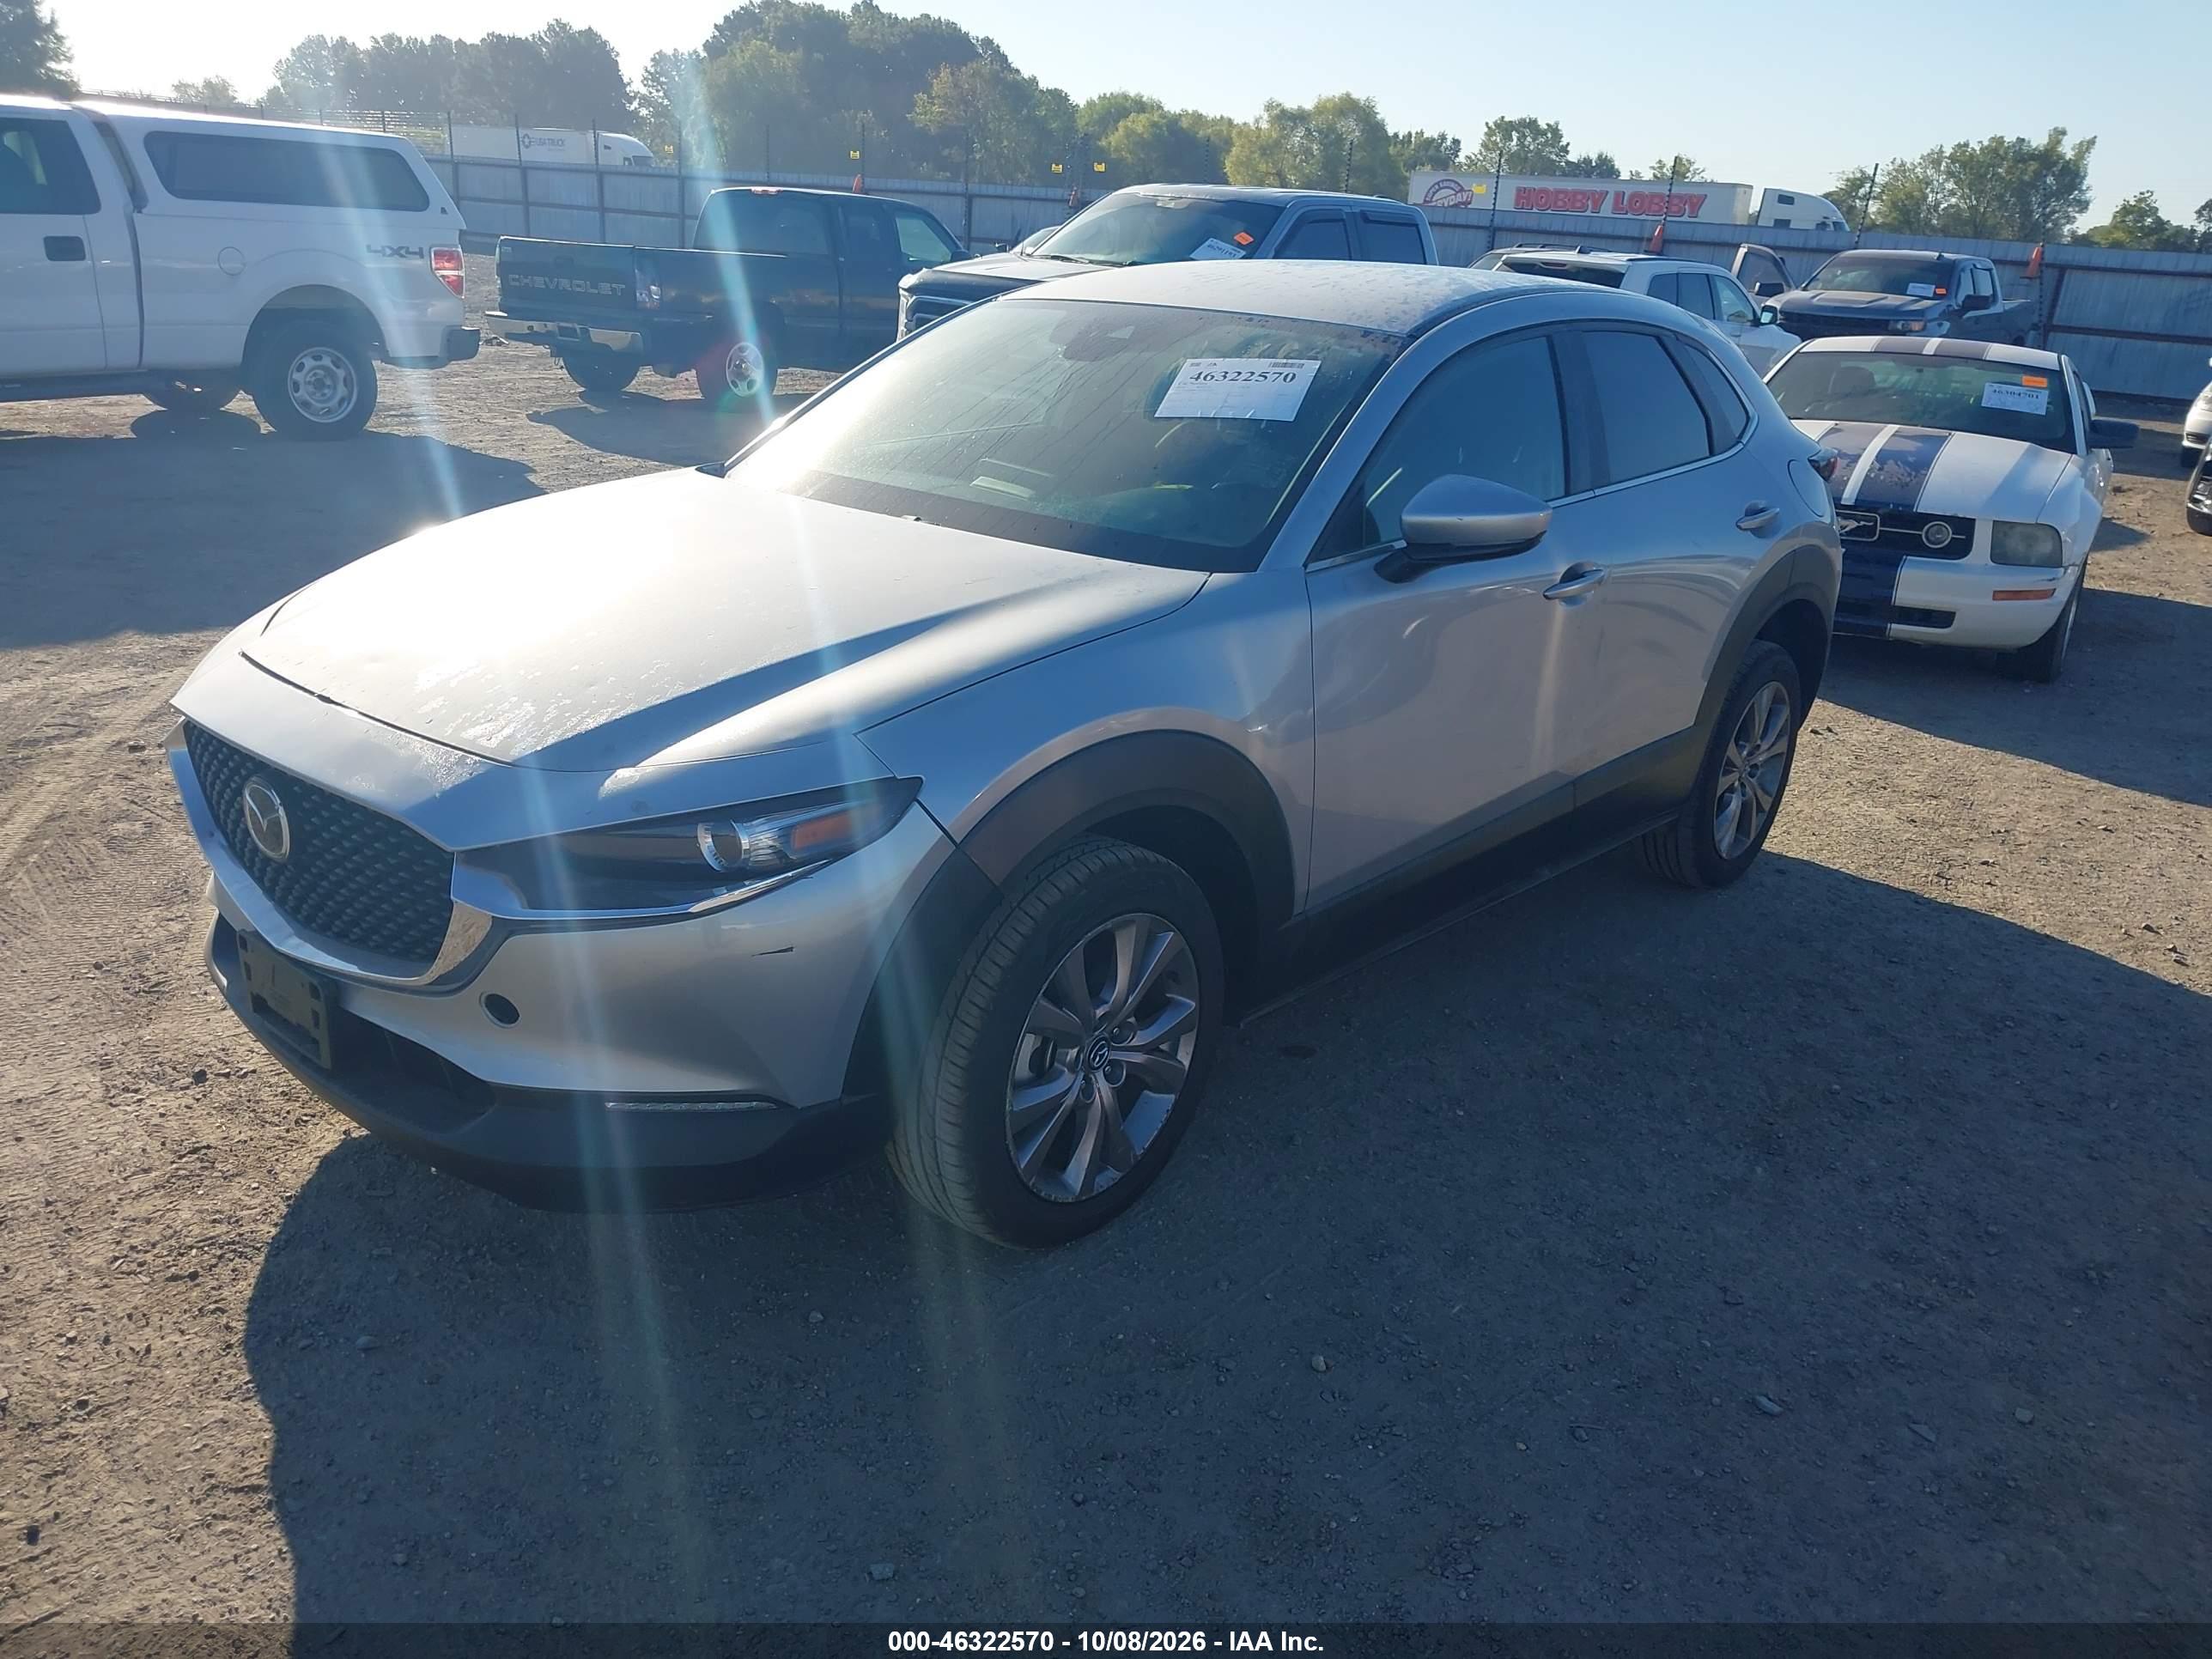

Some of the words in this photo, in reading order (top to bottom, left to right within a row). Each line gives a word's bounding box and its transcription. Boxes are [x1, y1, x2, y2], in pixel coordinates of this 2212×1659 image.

[1513, 185, 1608, 213] HOBBY
[1610, 190, 1707, 218] LOBBY
[507, 274, 626, 296] CHEVROLET
[1188, 370, 1297, 384] 46322570
